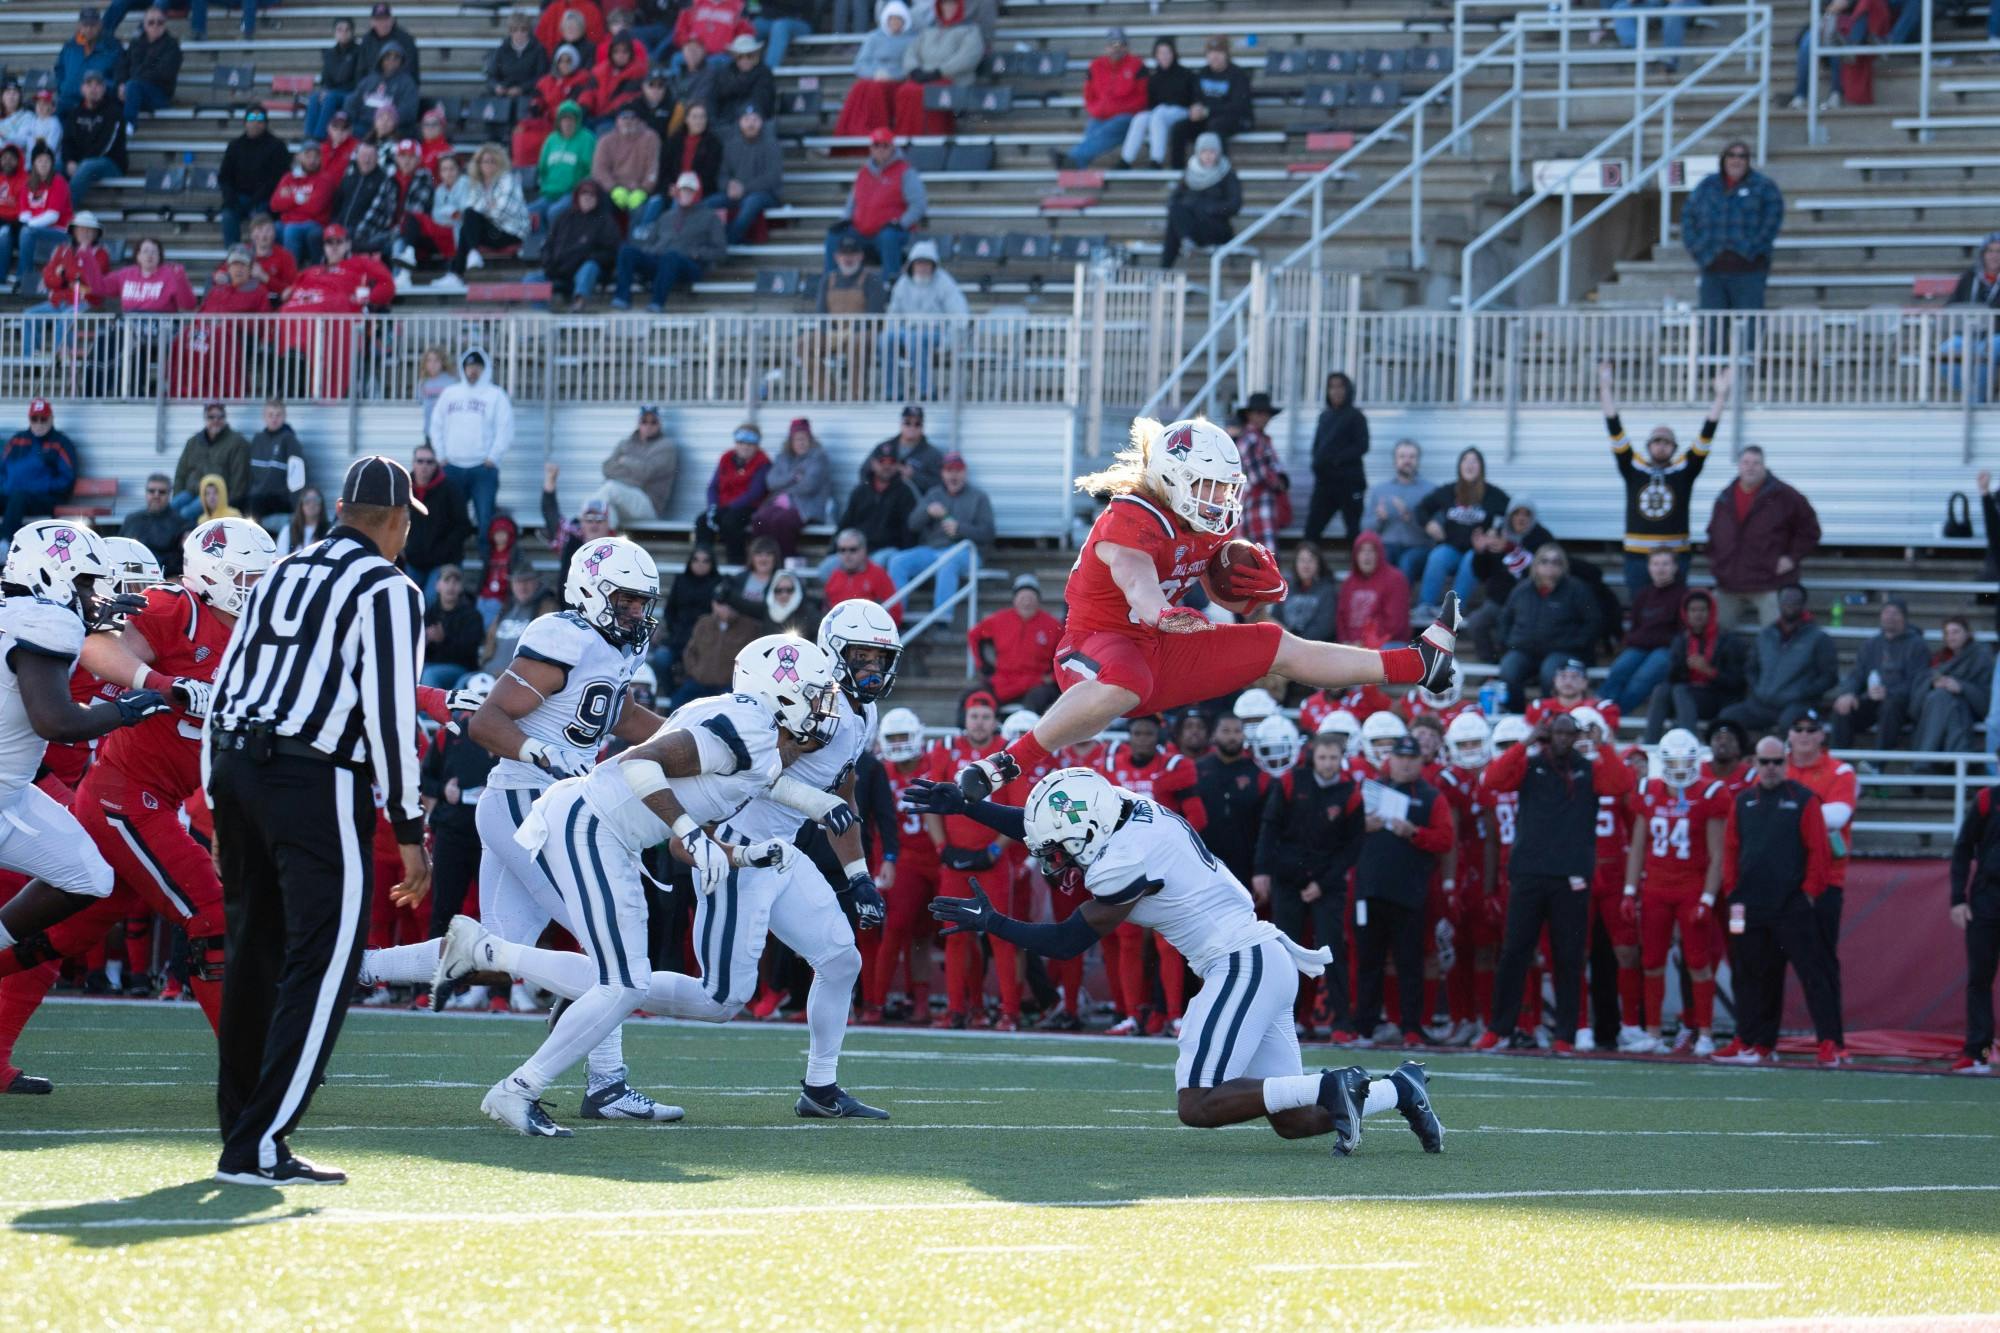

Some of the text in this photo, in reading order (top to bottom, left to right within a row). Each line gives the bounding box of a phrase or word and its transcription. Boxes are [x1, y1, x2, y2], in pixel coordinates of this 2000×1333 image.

[1602, 162, 1622, 188] D
[269, 563, 333, 637] U
[101, 682, 119, 698] BALL
[562, 679, 632, 749] 90
[1650, 815, 1691, 860] 84
